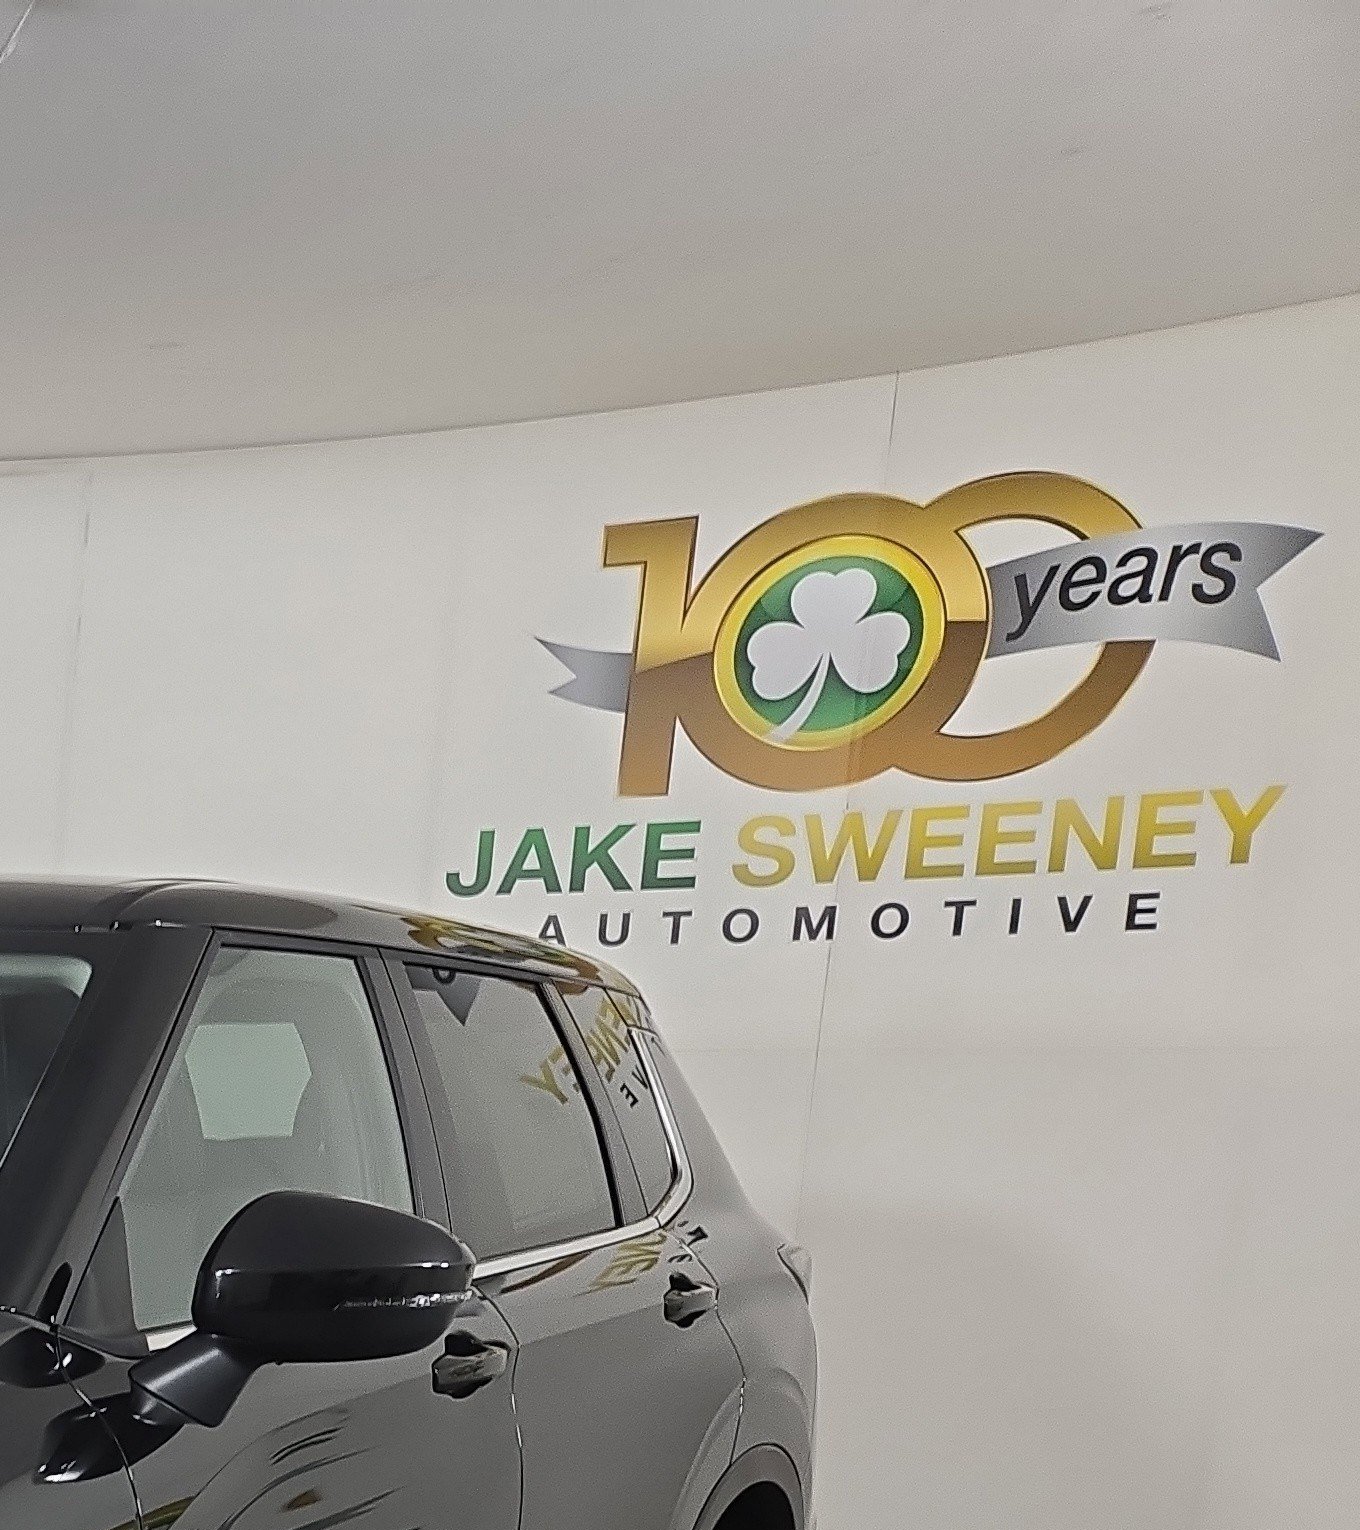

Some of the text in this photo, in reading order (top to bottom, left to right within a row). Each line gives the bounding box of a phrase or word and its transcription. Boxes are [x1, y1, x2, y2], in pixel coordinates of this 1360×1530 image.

[1006, 541, 1243, 642] years
[445, 785, 1289, 897] JAKE SWEENEY
[538, 892, 1160, 947] AUTOMOTIVE
